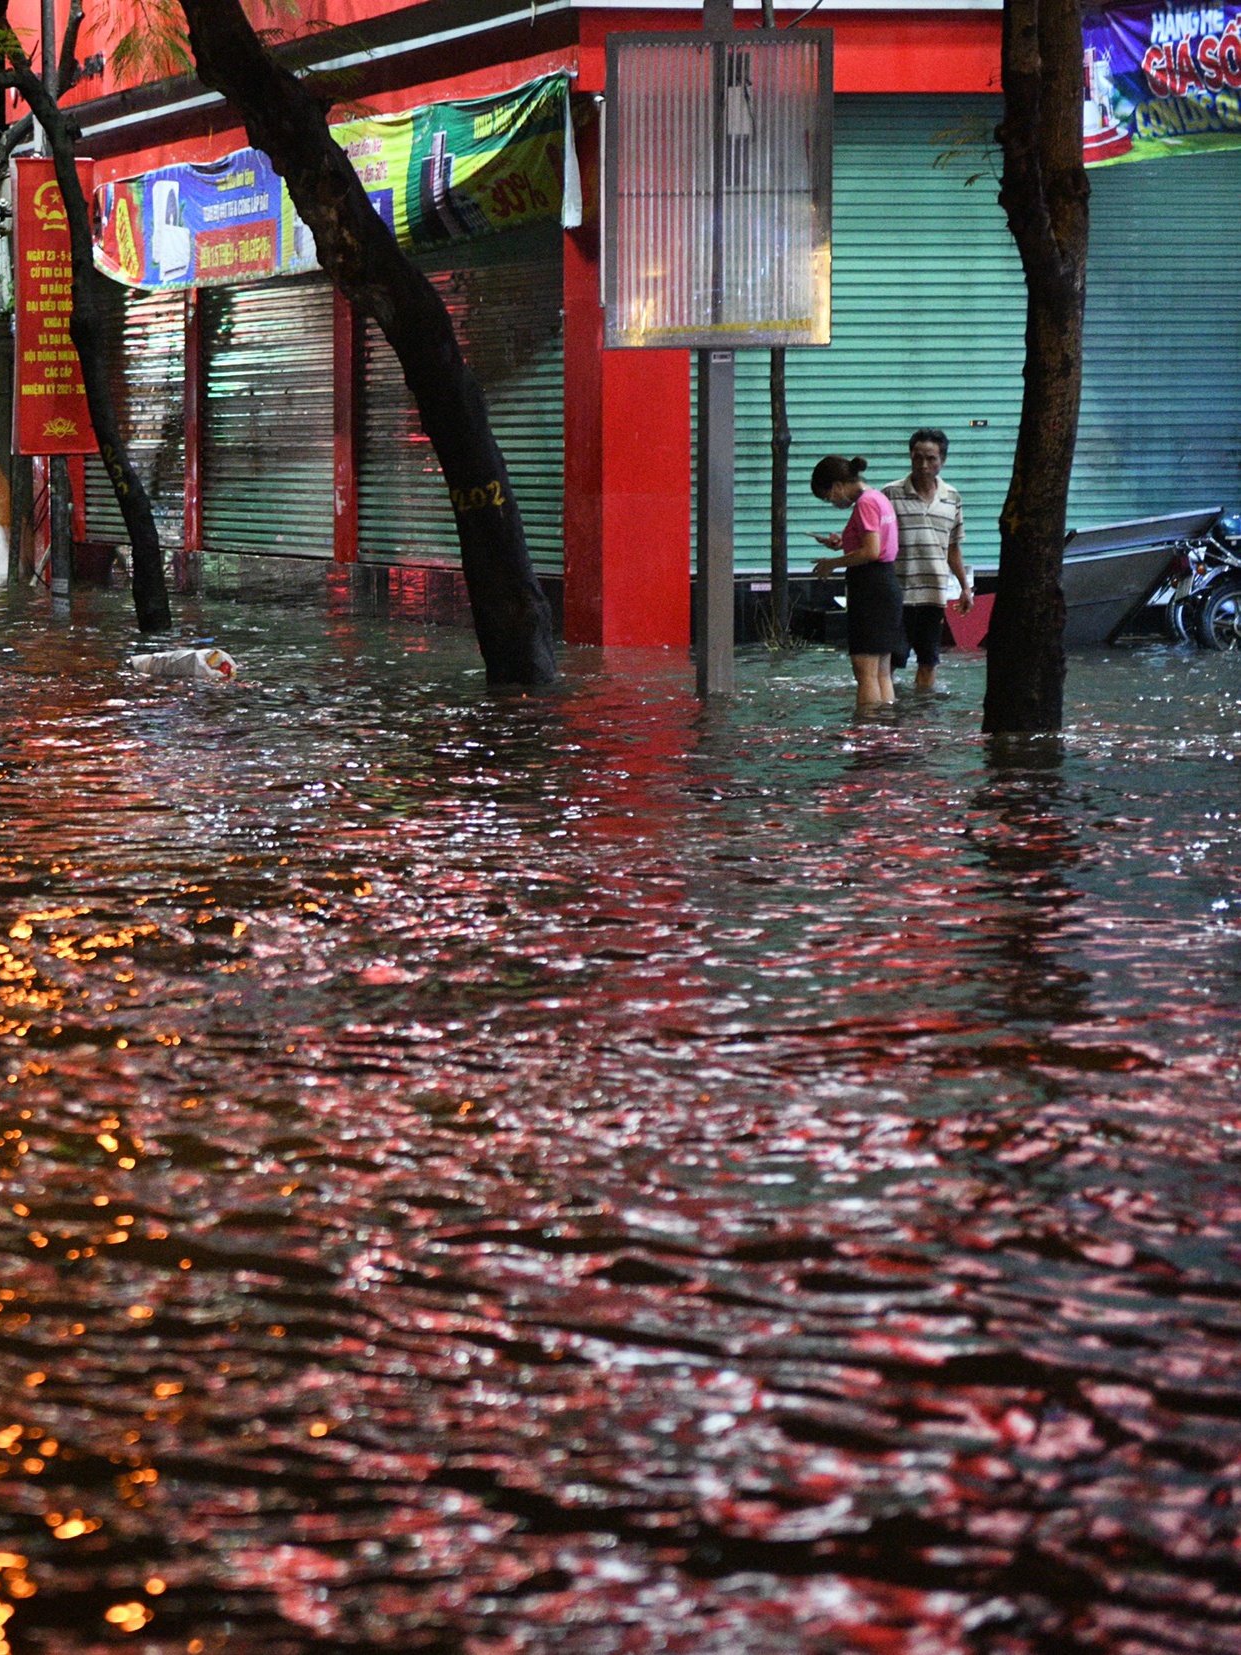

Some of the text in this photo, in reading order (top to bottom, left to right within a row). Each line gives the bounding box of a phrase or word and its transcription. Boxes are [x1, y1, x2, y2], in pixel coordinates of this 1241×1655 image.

[1141, 33, 1208, 99] GIÁ
[26, 248, 45, 261] NGÀY
[46, 250, 56, 262] 23
[30, 263, 41, 278] CỬ
[42, 267, 52, 278] TRI
[24, 349, 36, 364] HỘI
[38, 348, 56, 362] ĐỒNG
[44, 364, 72, 378] CÁC CẤP
[22, 383, 45, 397] NHIỆM
[451, 481, 506, 512] 202
